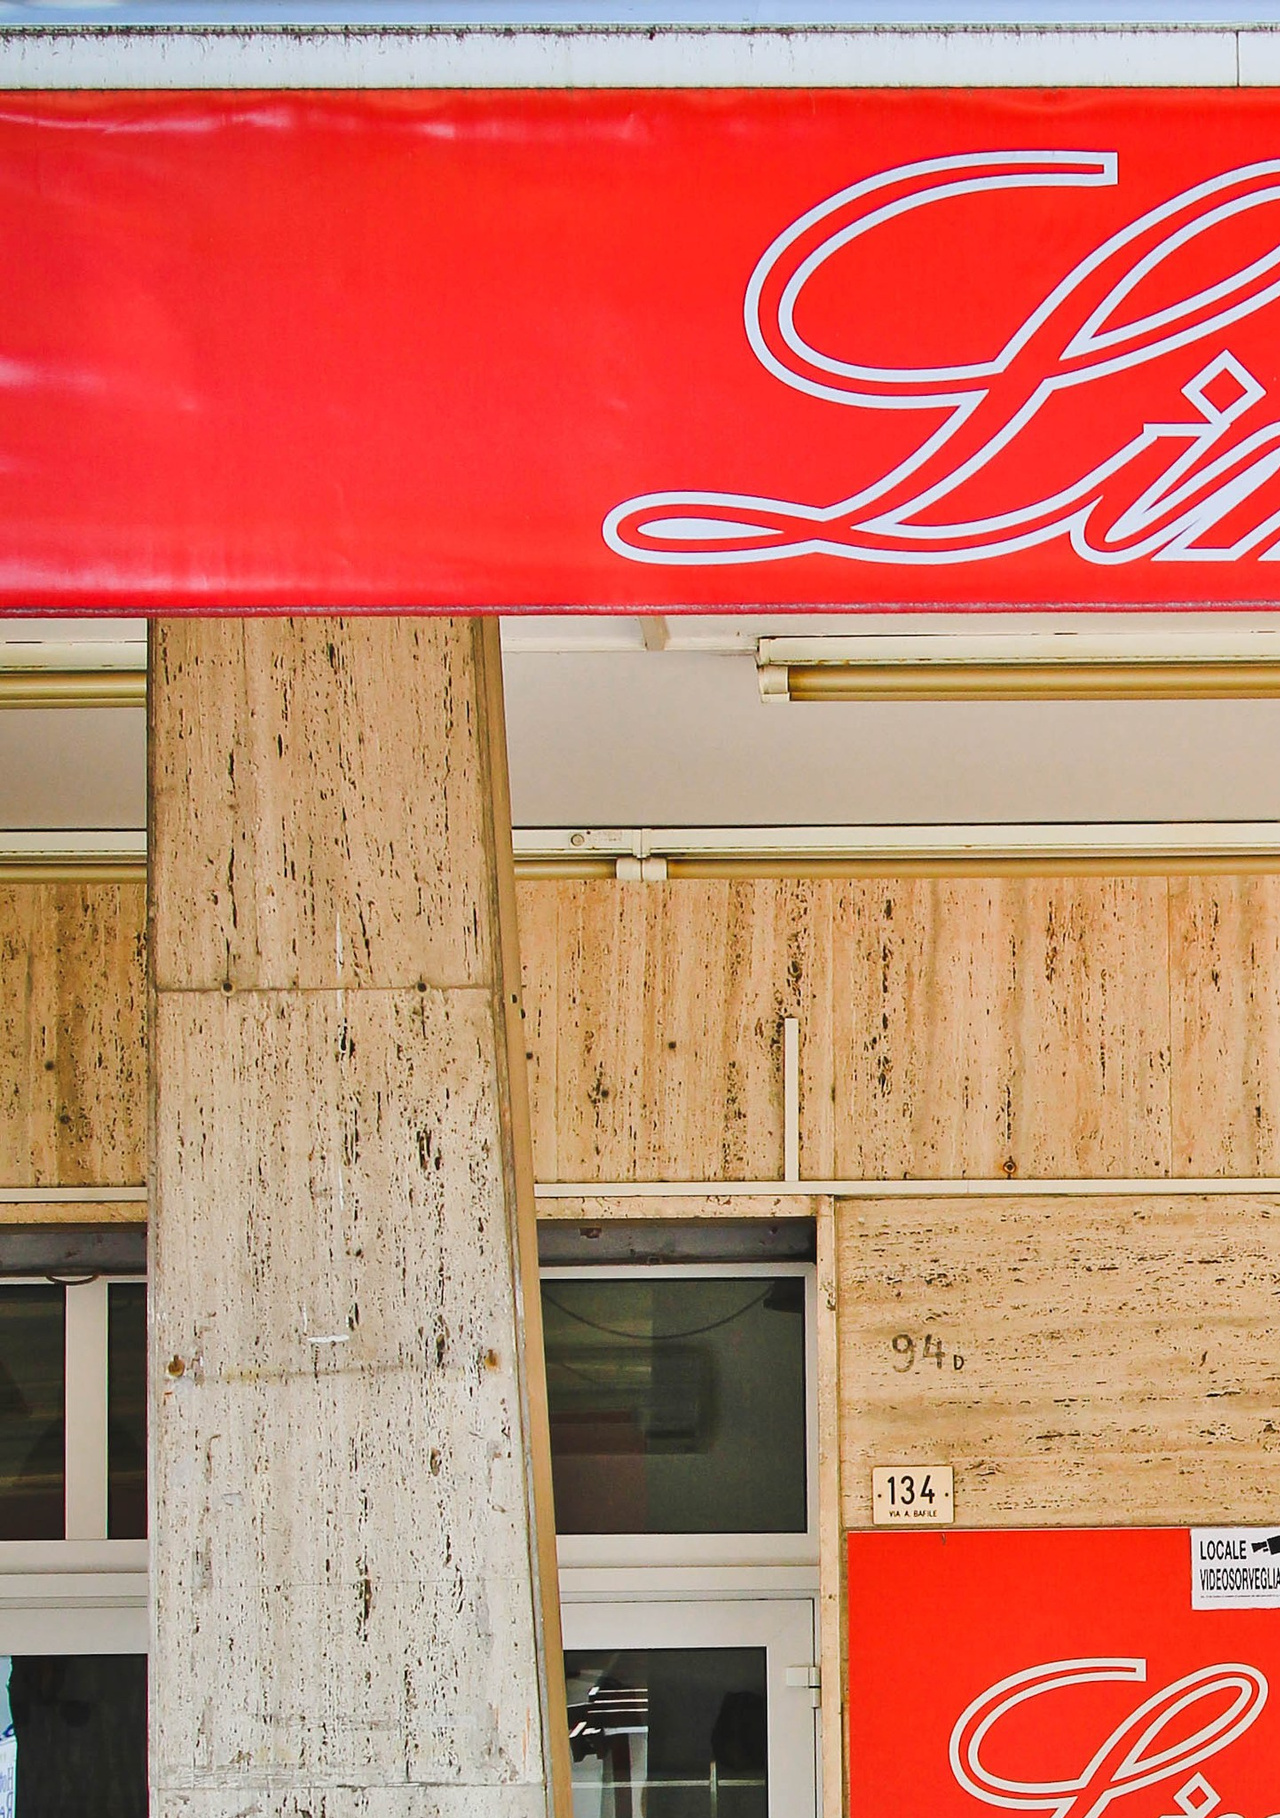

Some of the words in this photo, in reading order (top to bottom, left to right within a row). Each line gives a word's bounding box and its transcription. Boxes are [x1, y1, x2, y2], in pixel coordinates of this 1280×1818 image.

[891, 1333, 947, 1373] 94
[887, 1474, 936, 1506] 134
[888, 1509, 901, 1518] VIA
[913, 1508, 938, 1518] BAFILE
[1199, 1539, 1248, 1561] LOCALE
